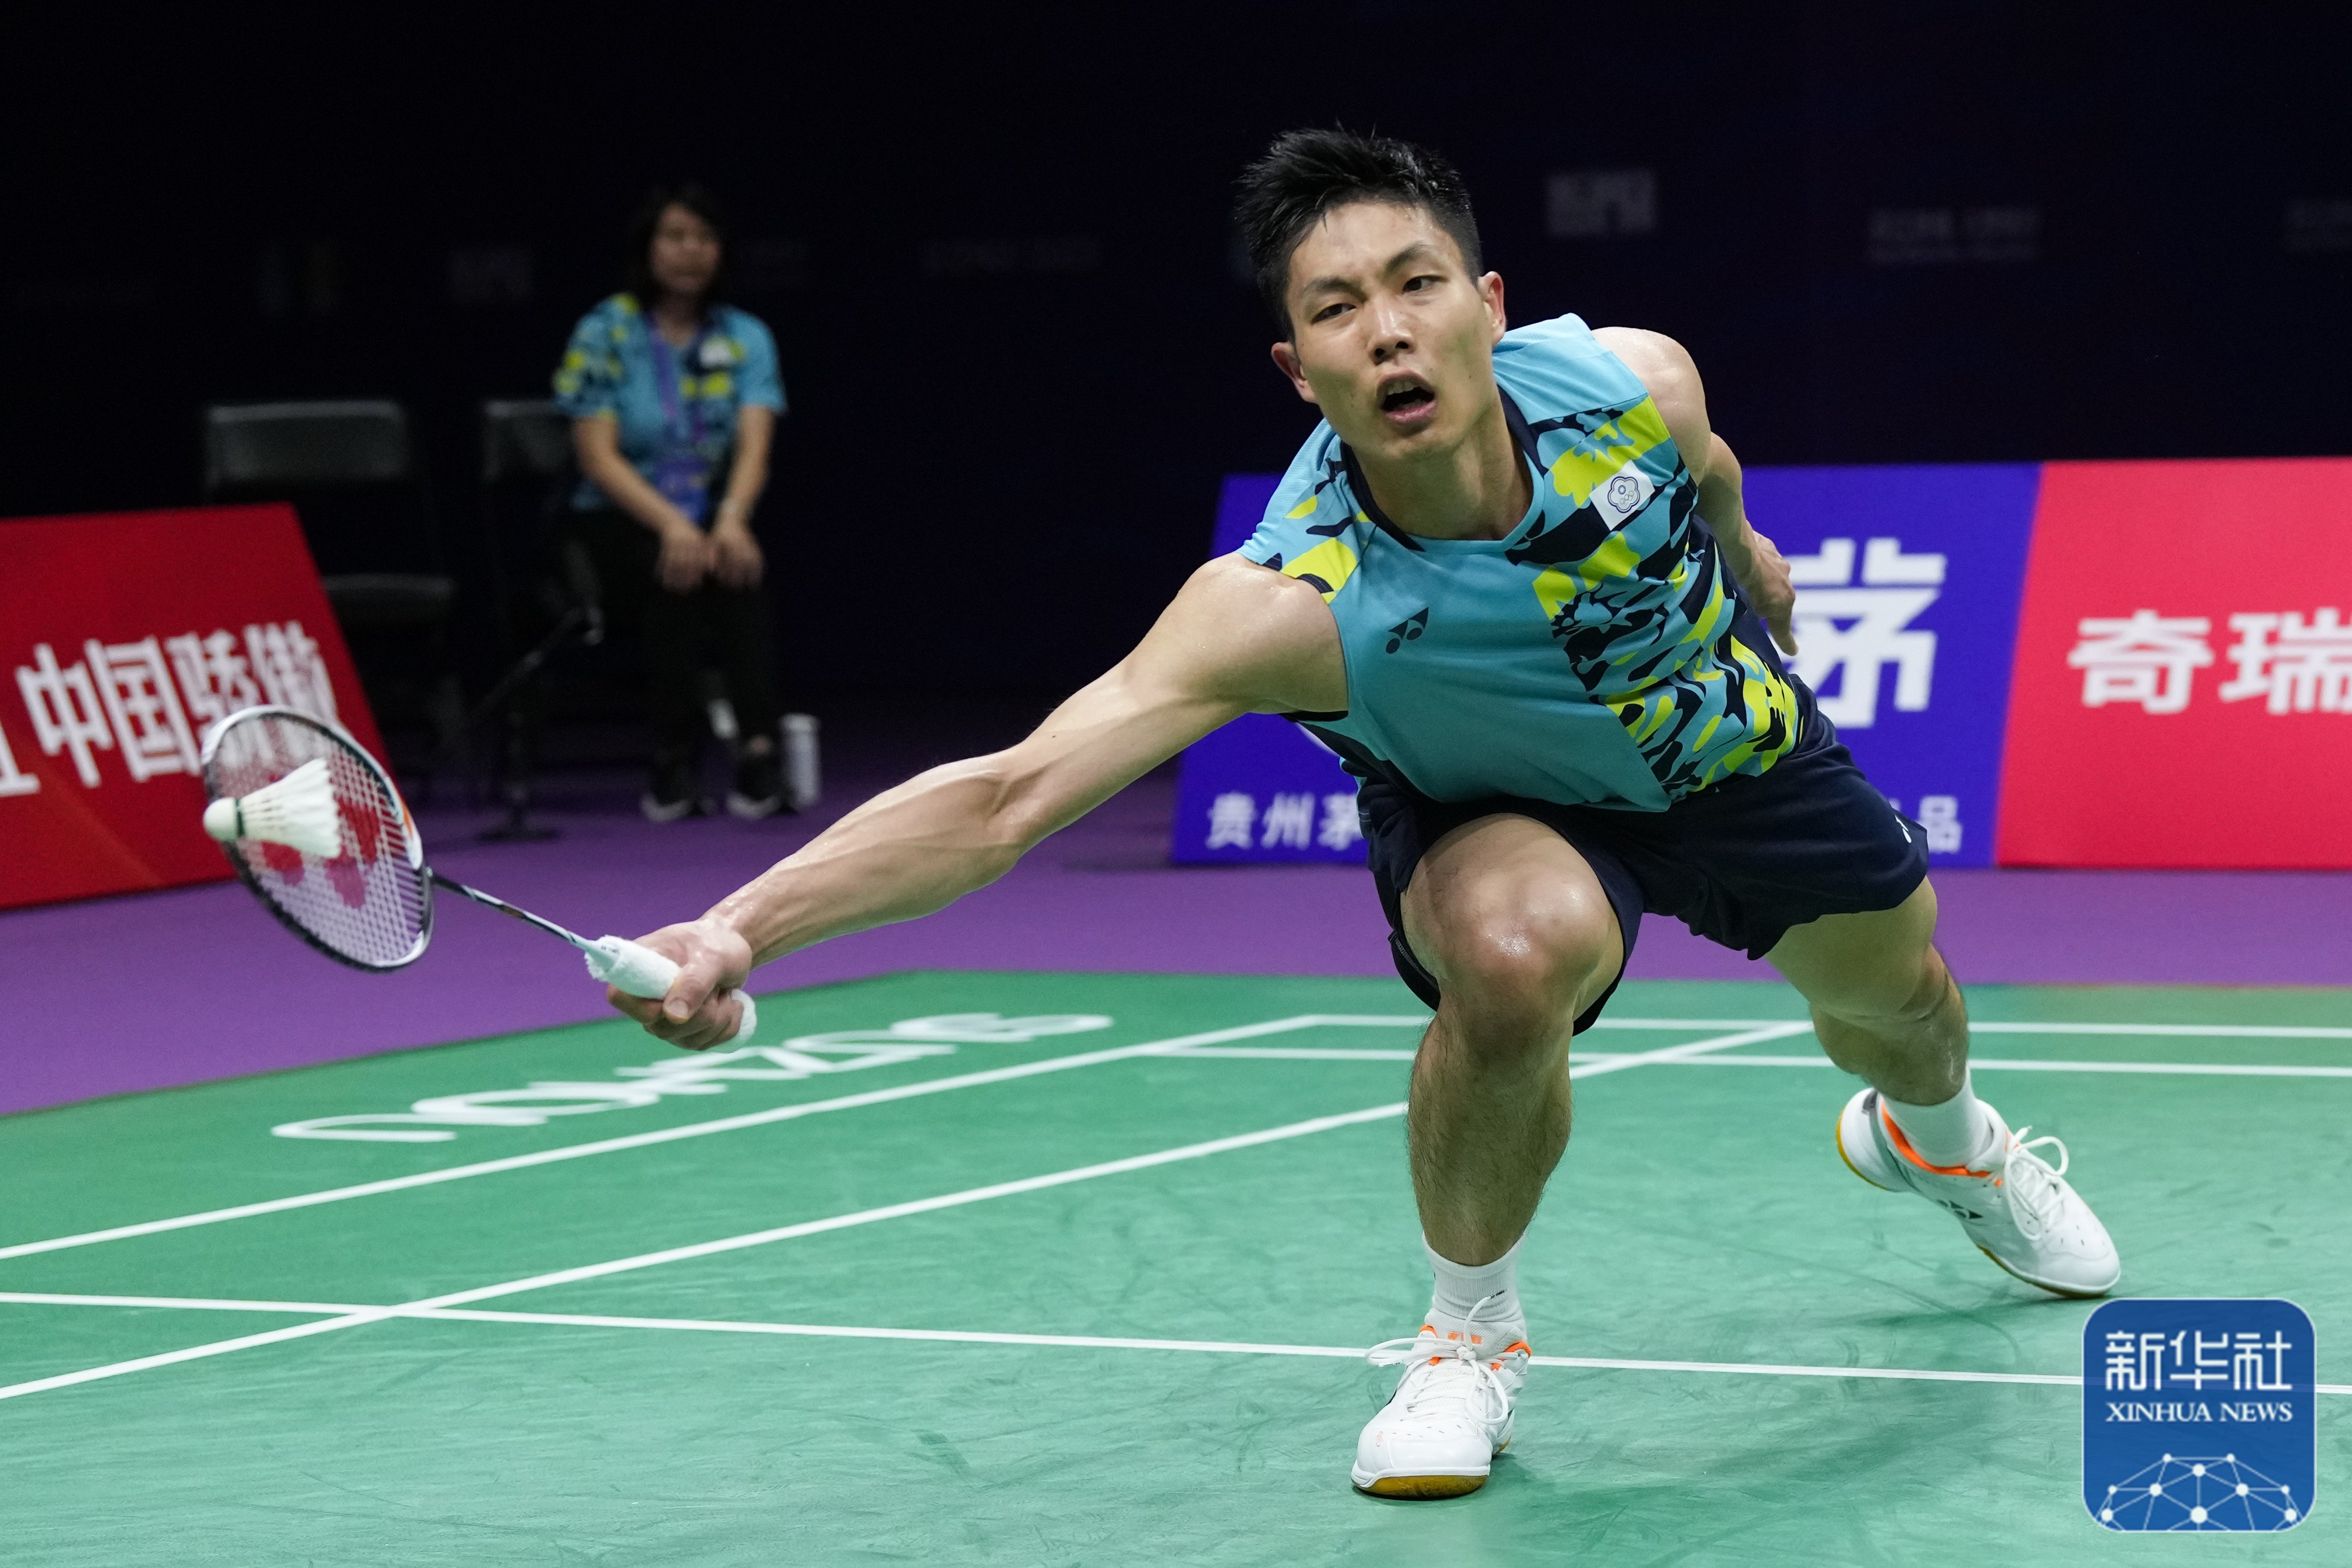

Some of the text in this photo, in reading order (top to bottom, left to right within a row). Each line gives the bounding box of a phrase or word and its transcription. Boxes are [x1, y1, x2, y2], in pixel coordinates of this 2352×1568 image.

[1771, 536, 1947, 729] 茅
[2067, 607, 2352, 716] 奇瑞
[1889, 795, 1963, 852] 品
